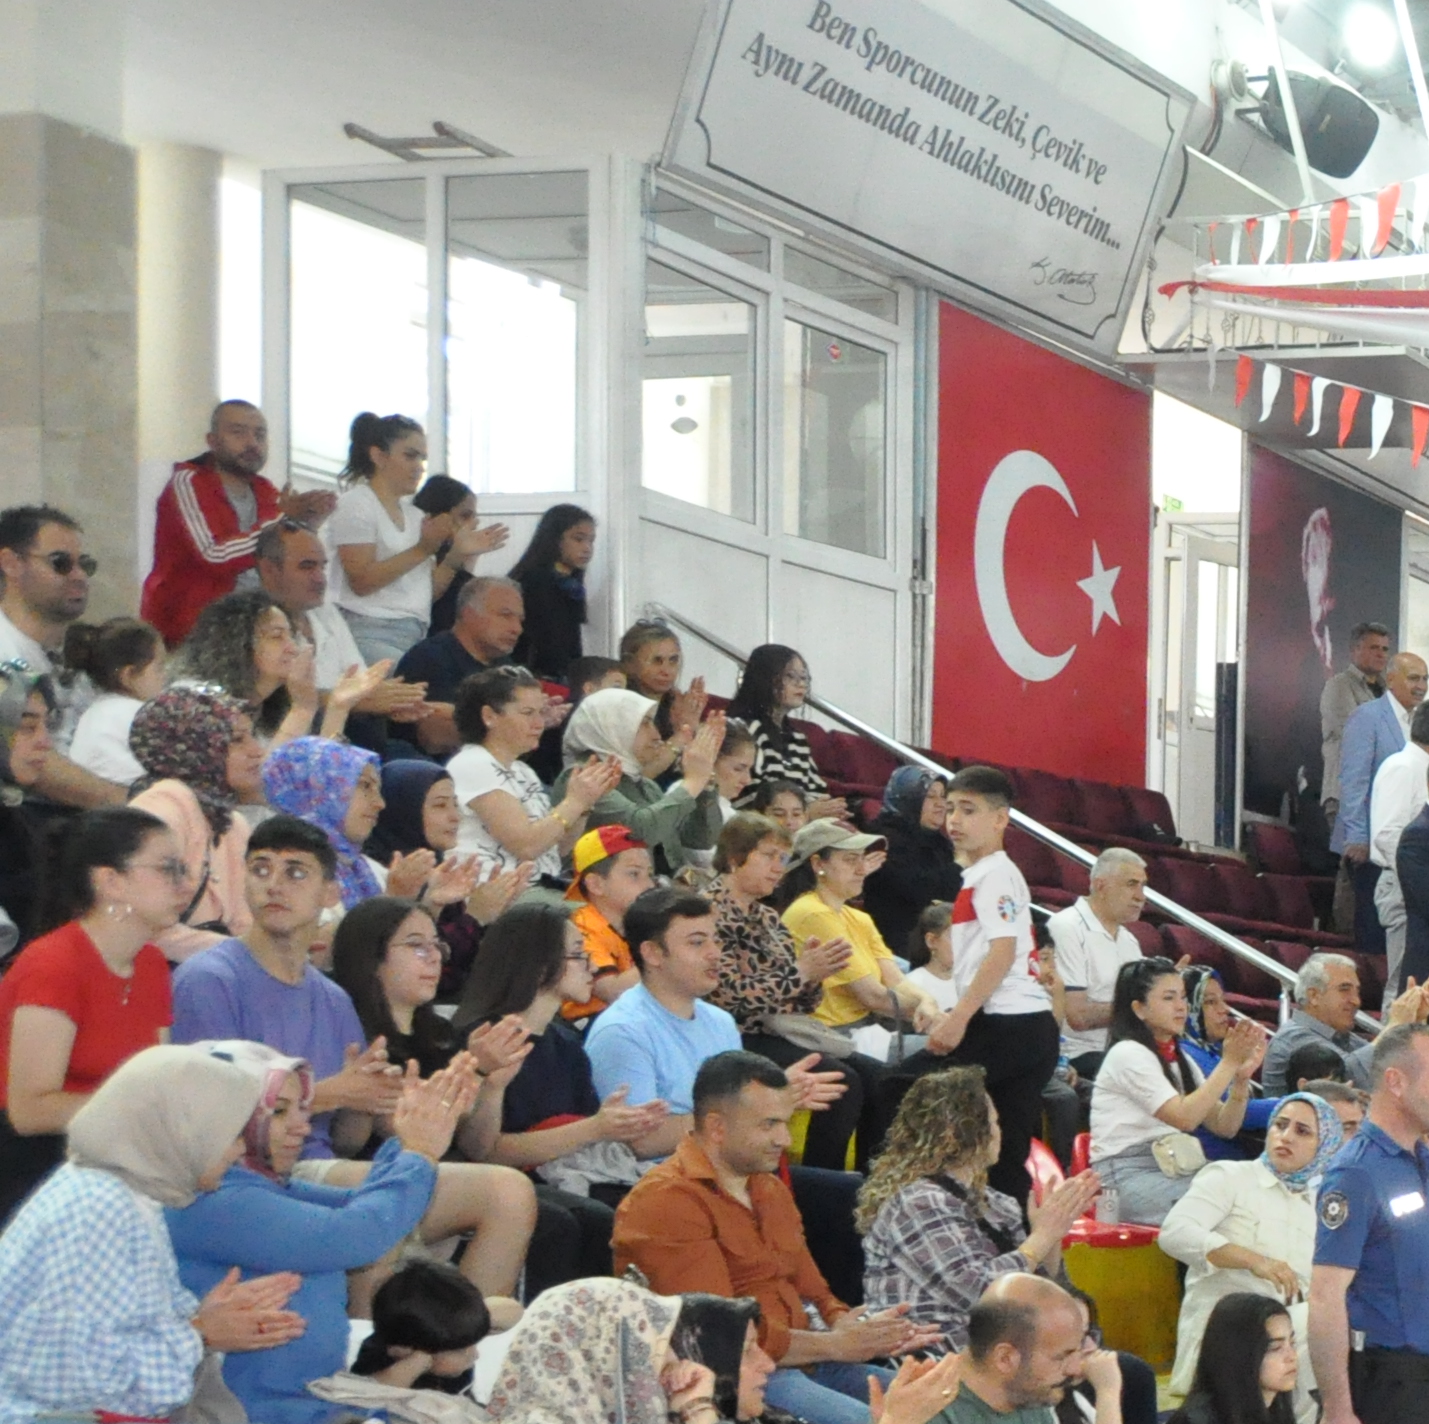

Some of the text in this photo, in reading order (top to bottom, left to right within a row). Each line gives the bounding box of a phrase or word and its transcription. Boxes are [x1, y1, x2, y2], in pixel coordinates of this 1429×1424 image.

[741, 32, 1121, 250] Aynı Zamanda Ahlaklısını Severim...
[806, 0, 1108, 185] Ben Sporcunun Zeki, Çevik ve
